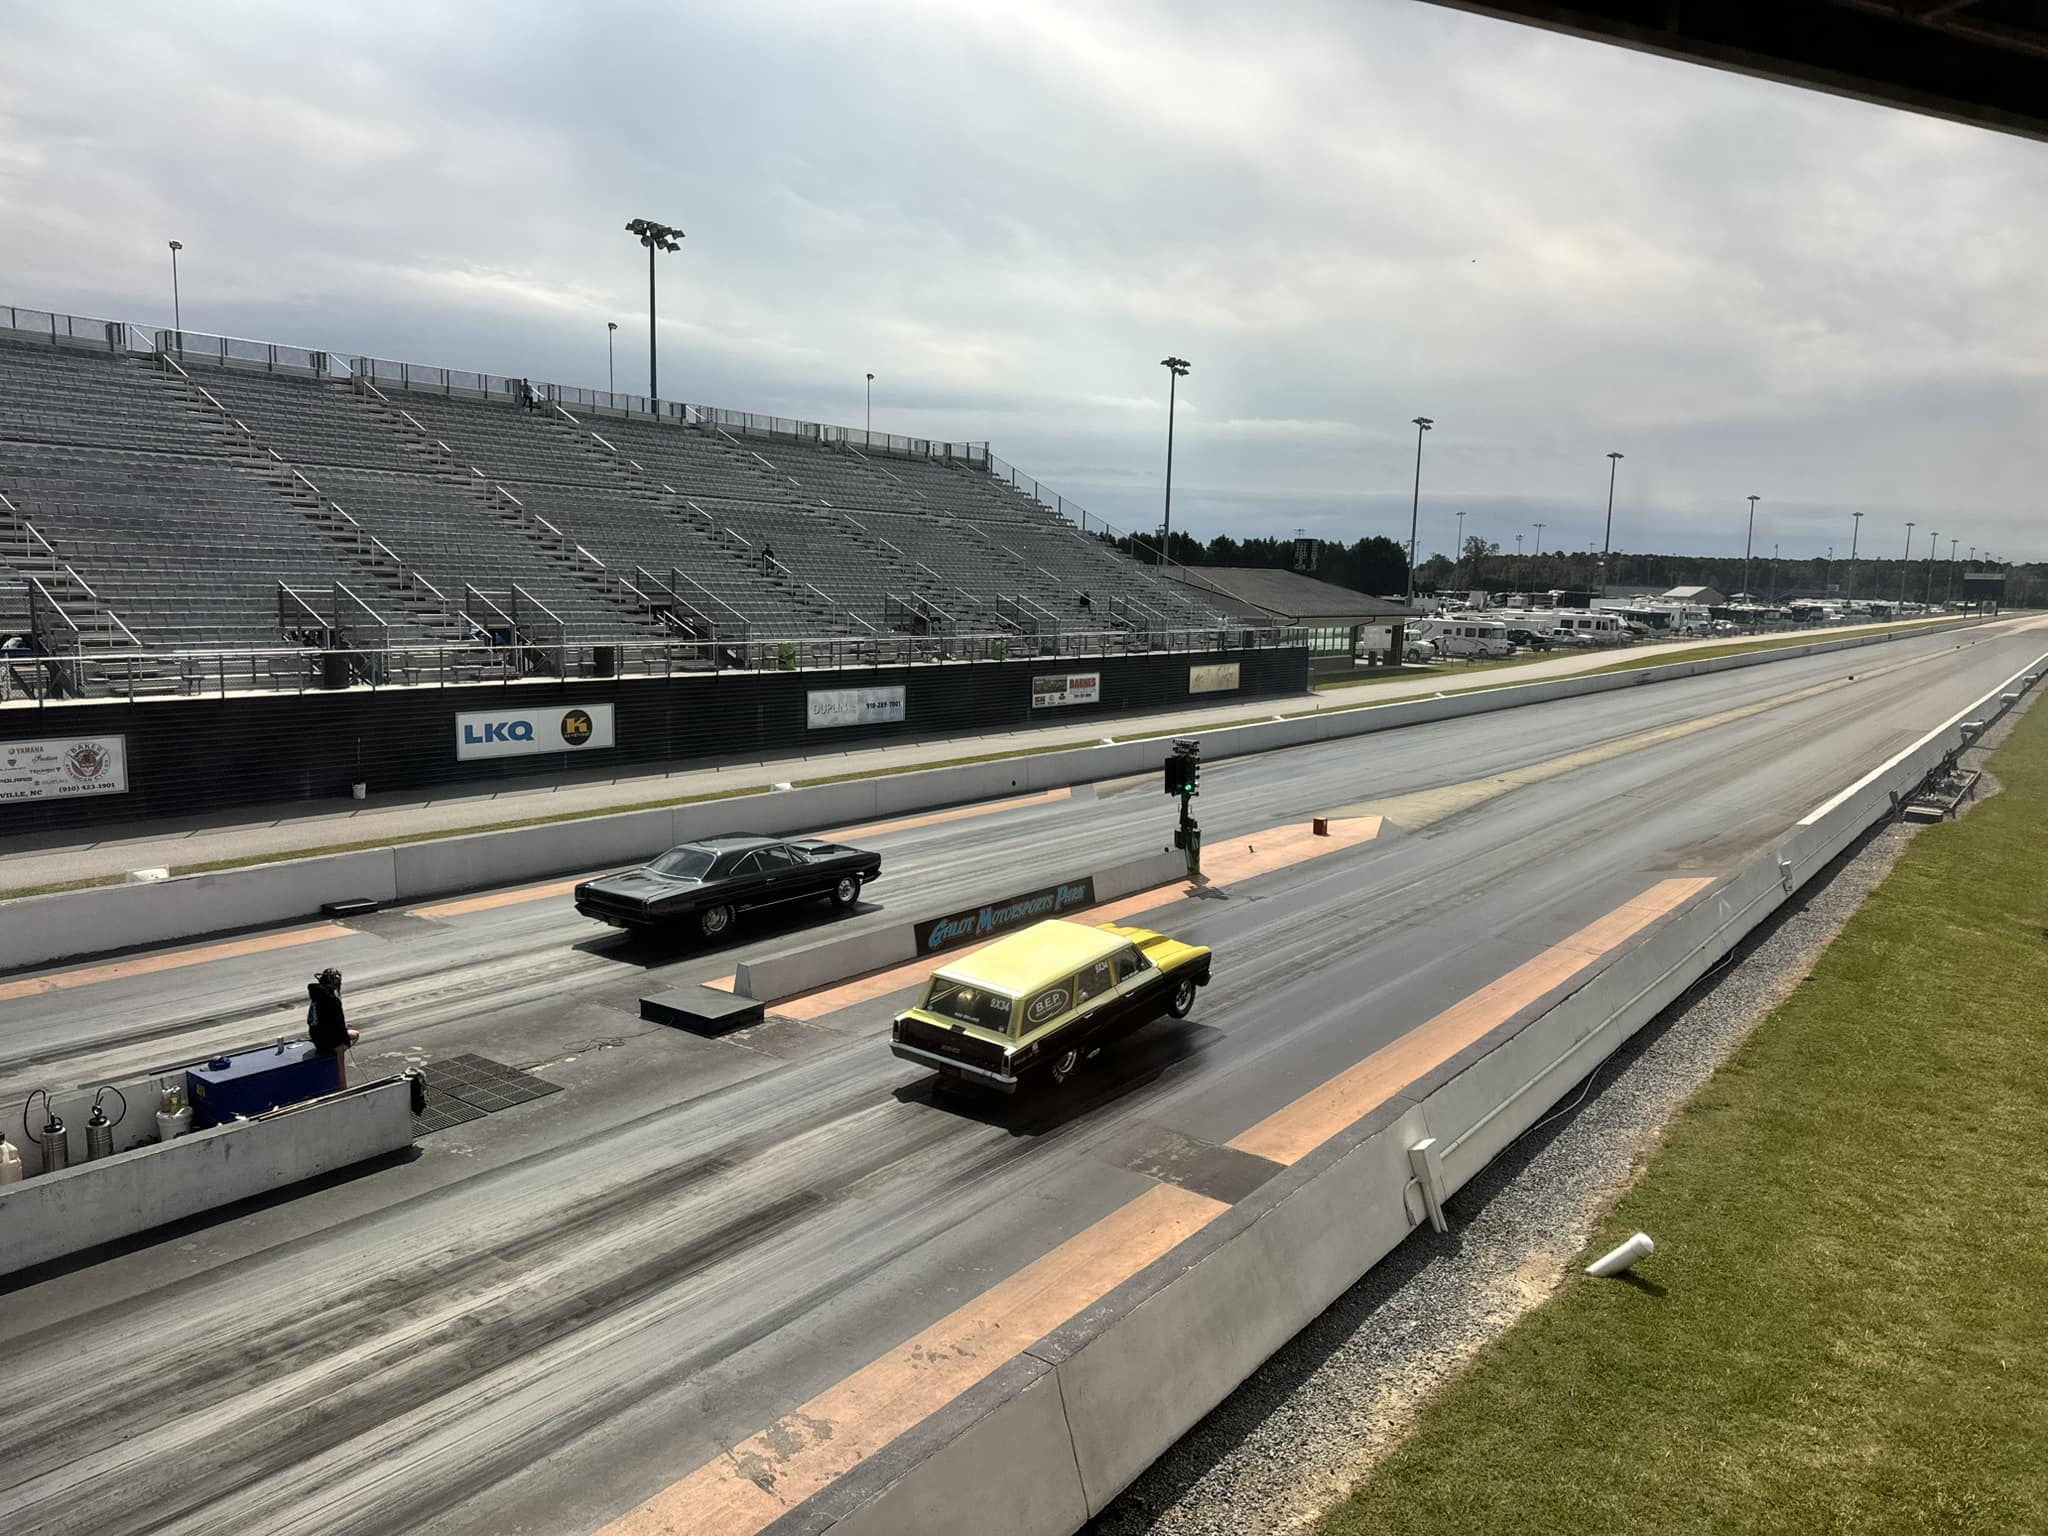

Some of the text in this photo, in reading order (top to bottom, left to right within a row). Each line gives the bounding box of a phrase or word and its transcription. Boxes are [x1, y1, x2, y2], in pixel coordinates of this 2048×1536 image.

[464, 720, 535, 744] LKQ
[16, 746, 44, 754] YAMAHA
[59, 785, 80, 793] (910)
[1054, 884, 1086, 911] PARK
